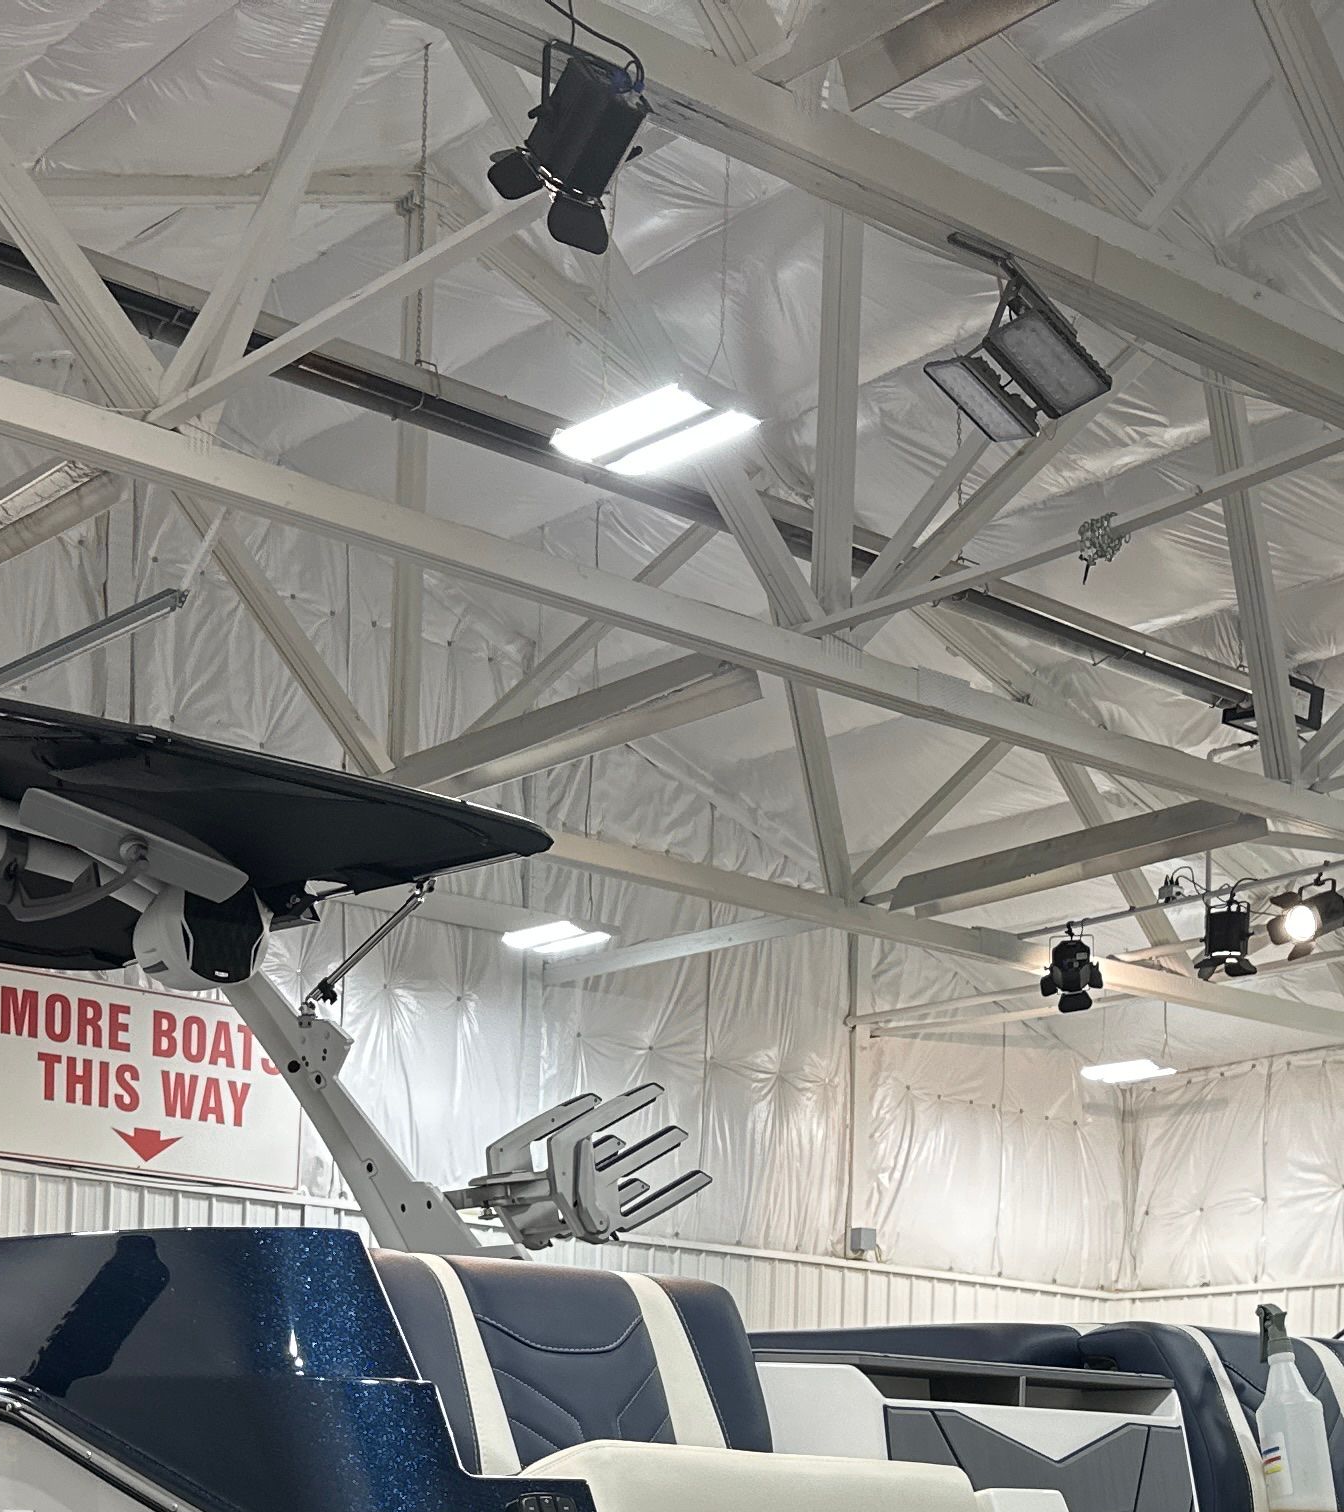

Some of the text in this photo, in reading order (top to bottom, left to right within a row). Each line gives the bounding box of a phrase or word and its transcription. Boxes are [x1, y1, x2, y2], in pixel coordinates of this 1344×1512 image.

[0, 985, 132, 1052] MORE
[37, 1052, 252, 1127] THIS WAY
